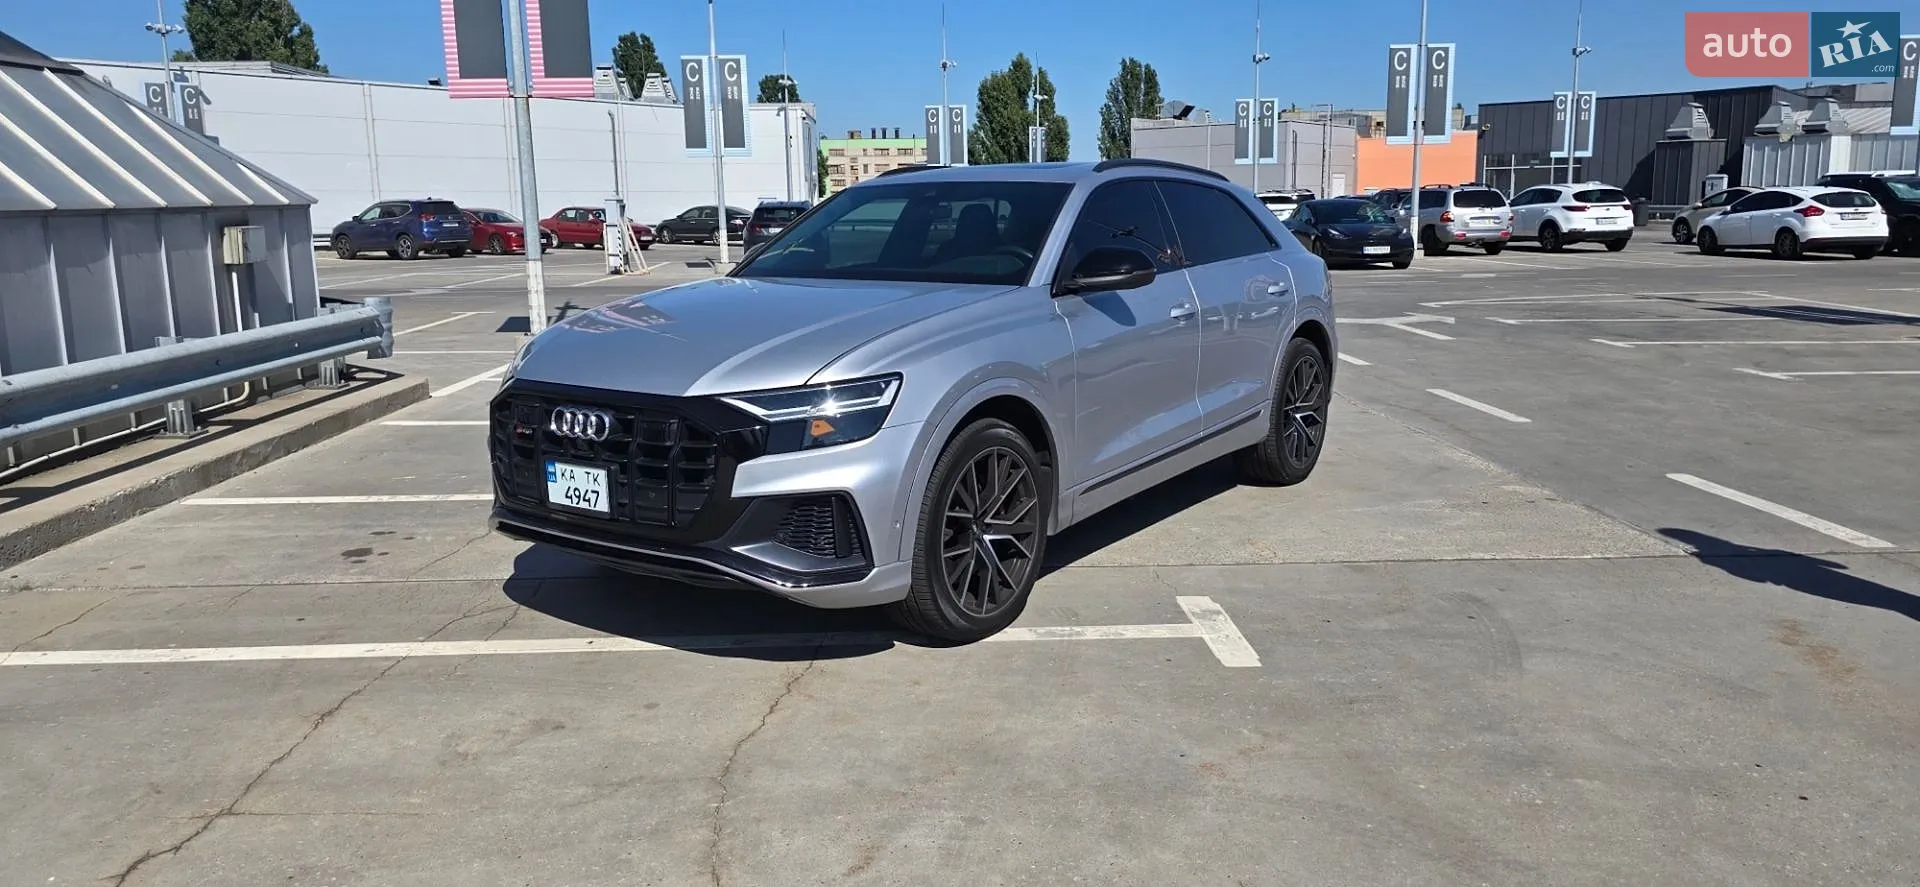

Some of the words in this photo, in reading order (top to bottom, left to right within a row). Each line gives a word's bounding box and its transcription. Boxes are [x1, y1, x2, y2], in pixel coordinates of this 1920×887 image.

[1903, 41, 1917, 61] C
[1394, 51, 1407, 71] C
[1432, 50, 1445, 70] C
[686, 62, 700, 82] C
[724, 61, 738, 81] C
[149, 86, 161, 102] C
[184, 88, 196, 104] C
[1581, 95, 1590, 109] C
[1238, 103, 1247, 116] C
[1263, 102, 1272, 115] C
[1556, 96, 1566, 109] C
[928, 109, 937, 123] C
[952, 108, 961, 122] C
[560, 468, 576, 482] KA
[584, 471, 600, 486] TK
[565, 485, 600, 509] 4947
